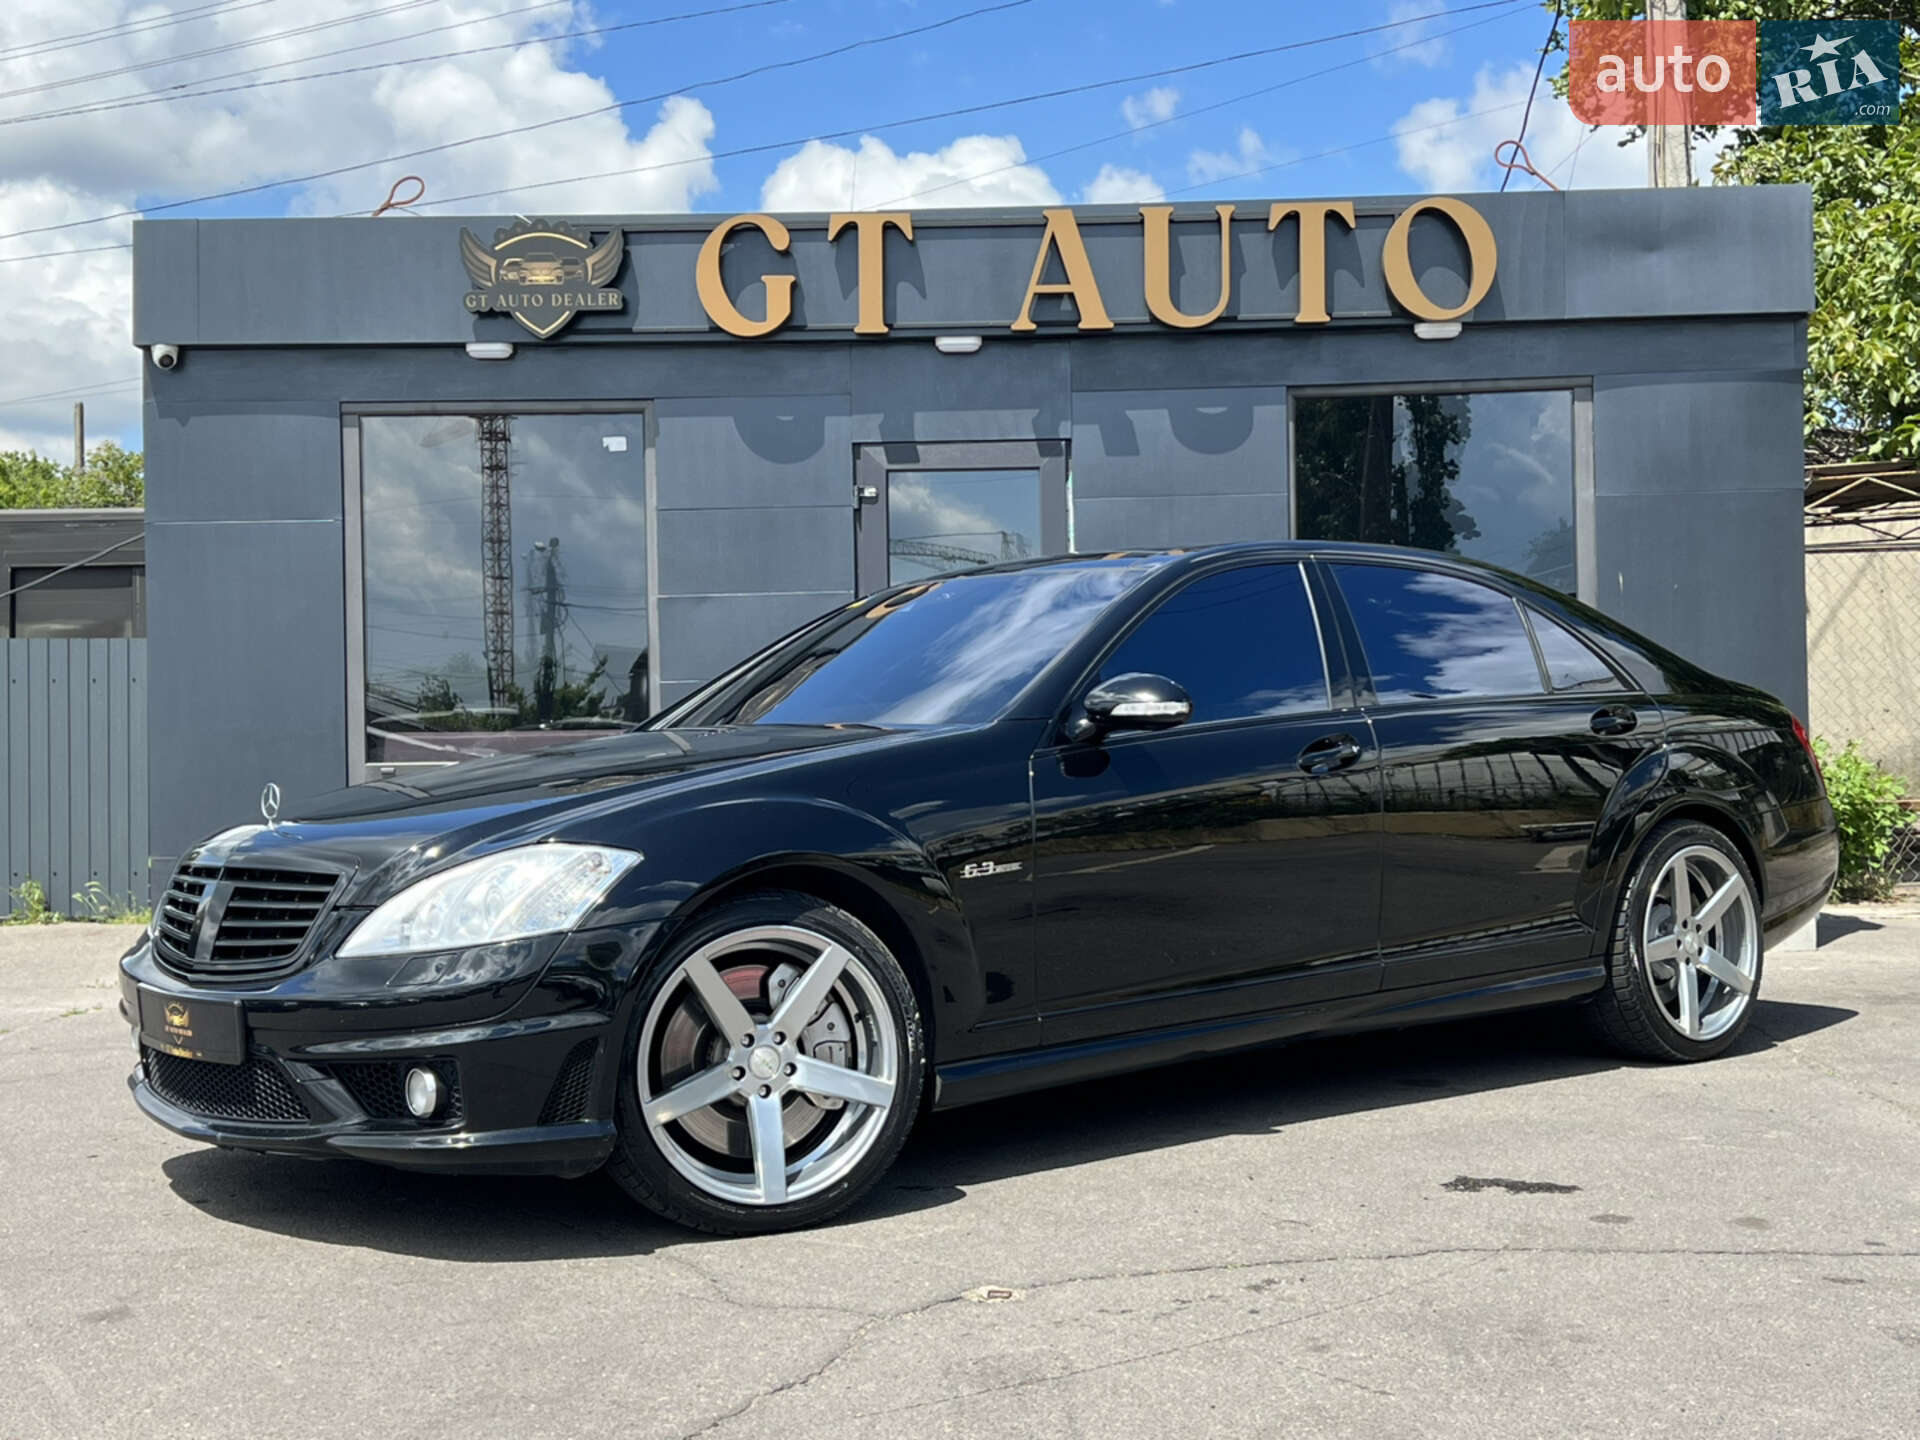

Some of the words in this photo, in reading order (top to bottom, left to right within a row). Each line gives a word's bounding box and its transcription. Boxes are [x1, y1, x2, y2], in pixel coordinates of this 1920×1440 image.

[465, 295, 488, 308] GT
[496, 294, 544, 308] AUTO
[551, 292, 619, 308] DEALER
[695, 211, 914, 336] GT
[1009, 196, 1498, 332] AUTO
